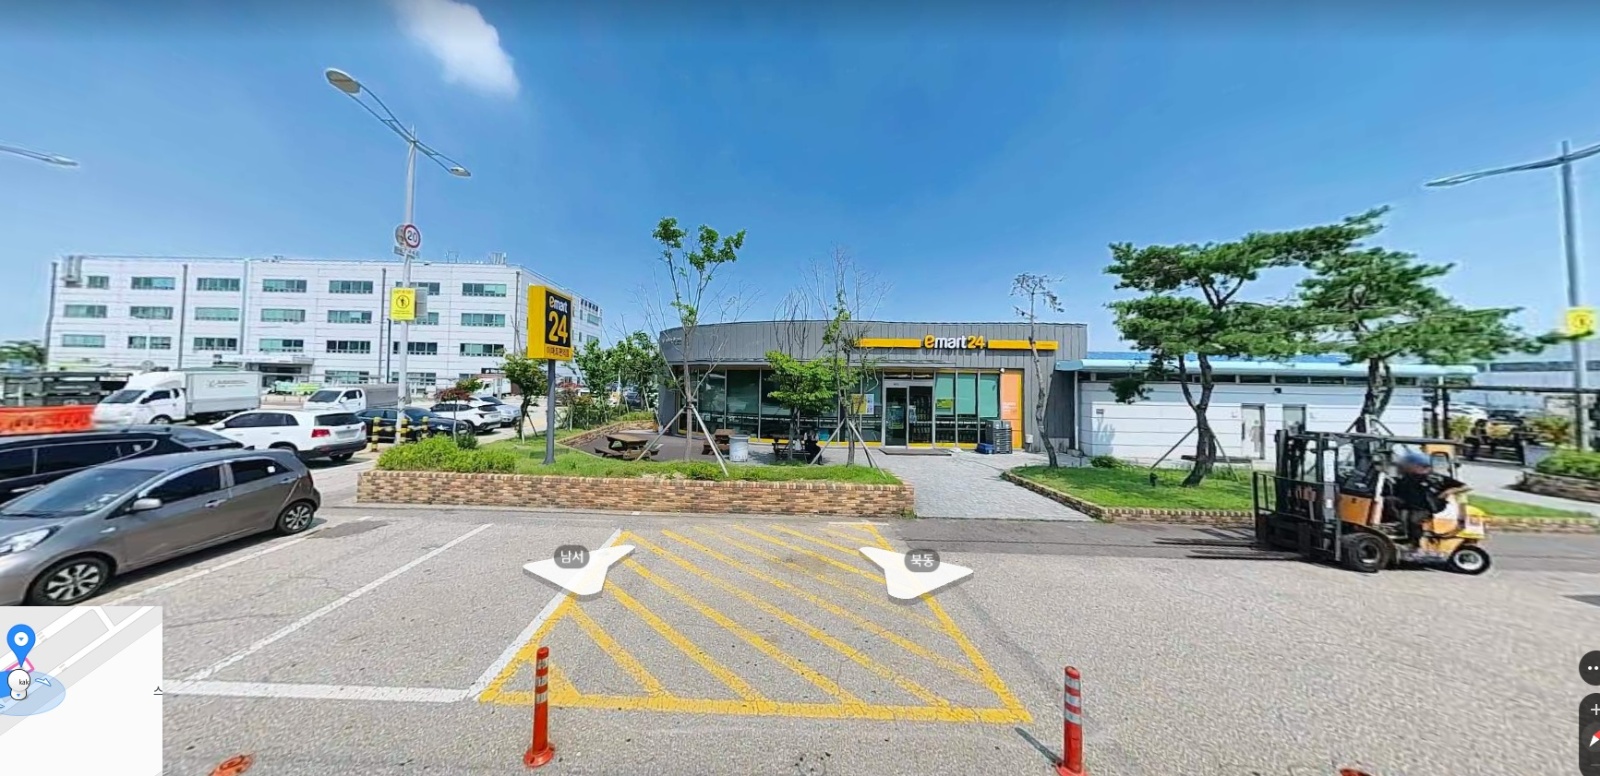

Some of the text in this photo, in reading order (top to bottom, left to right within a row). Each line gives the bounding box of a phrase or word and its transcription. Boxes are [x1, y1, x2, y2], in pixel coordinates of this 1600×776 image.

[407, 230, 418, 242] 20
[549, 295, 568, 313] emart
[548, 311, 568, 344] 24
